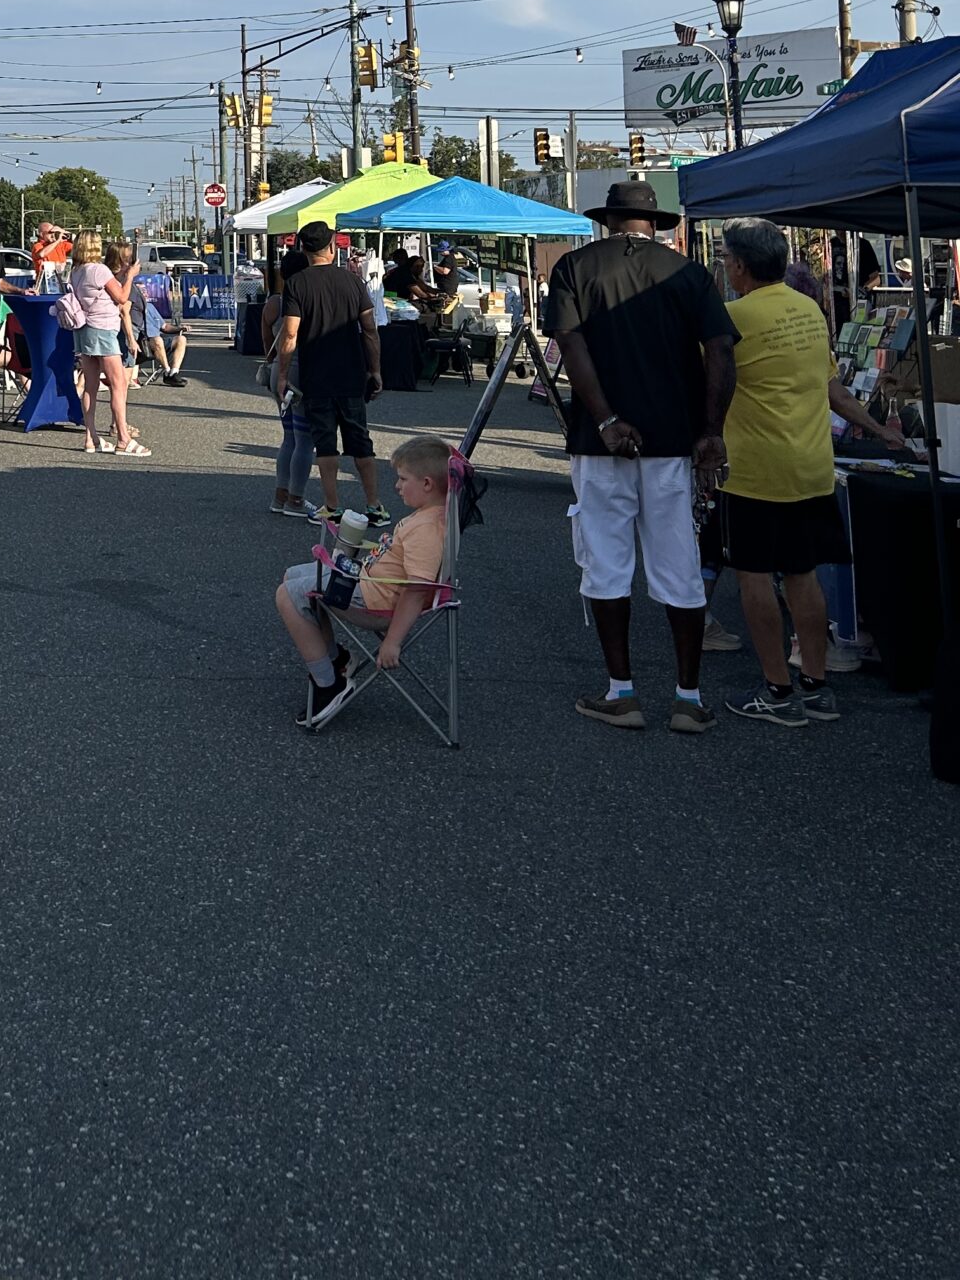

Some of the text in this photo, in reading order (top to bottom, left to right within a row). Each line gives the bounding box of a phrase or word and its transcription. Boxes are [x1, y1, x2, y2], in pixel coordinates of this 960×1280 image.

[676, 52, 699, 63] Sons
[704, 48, 752, 63] Welces
[755, 44, 776, 61] You
[779, 43, 789, 55] to
[656, 63, 803, 114] Mafair
